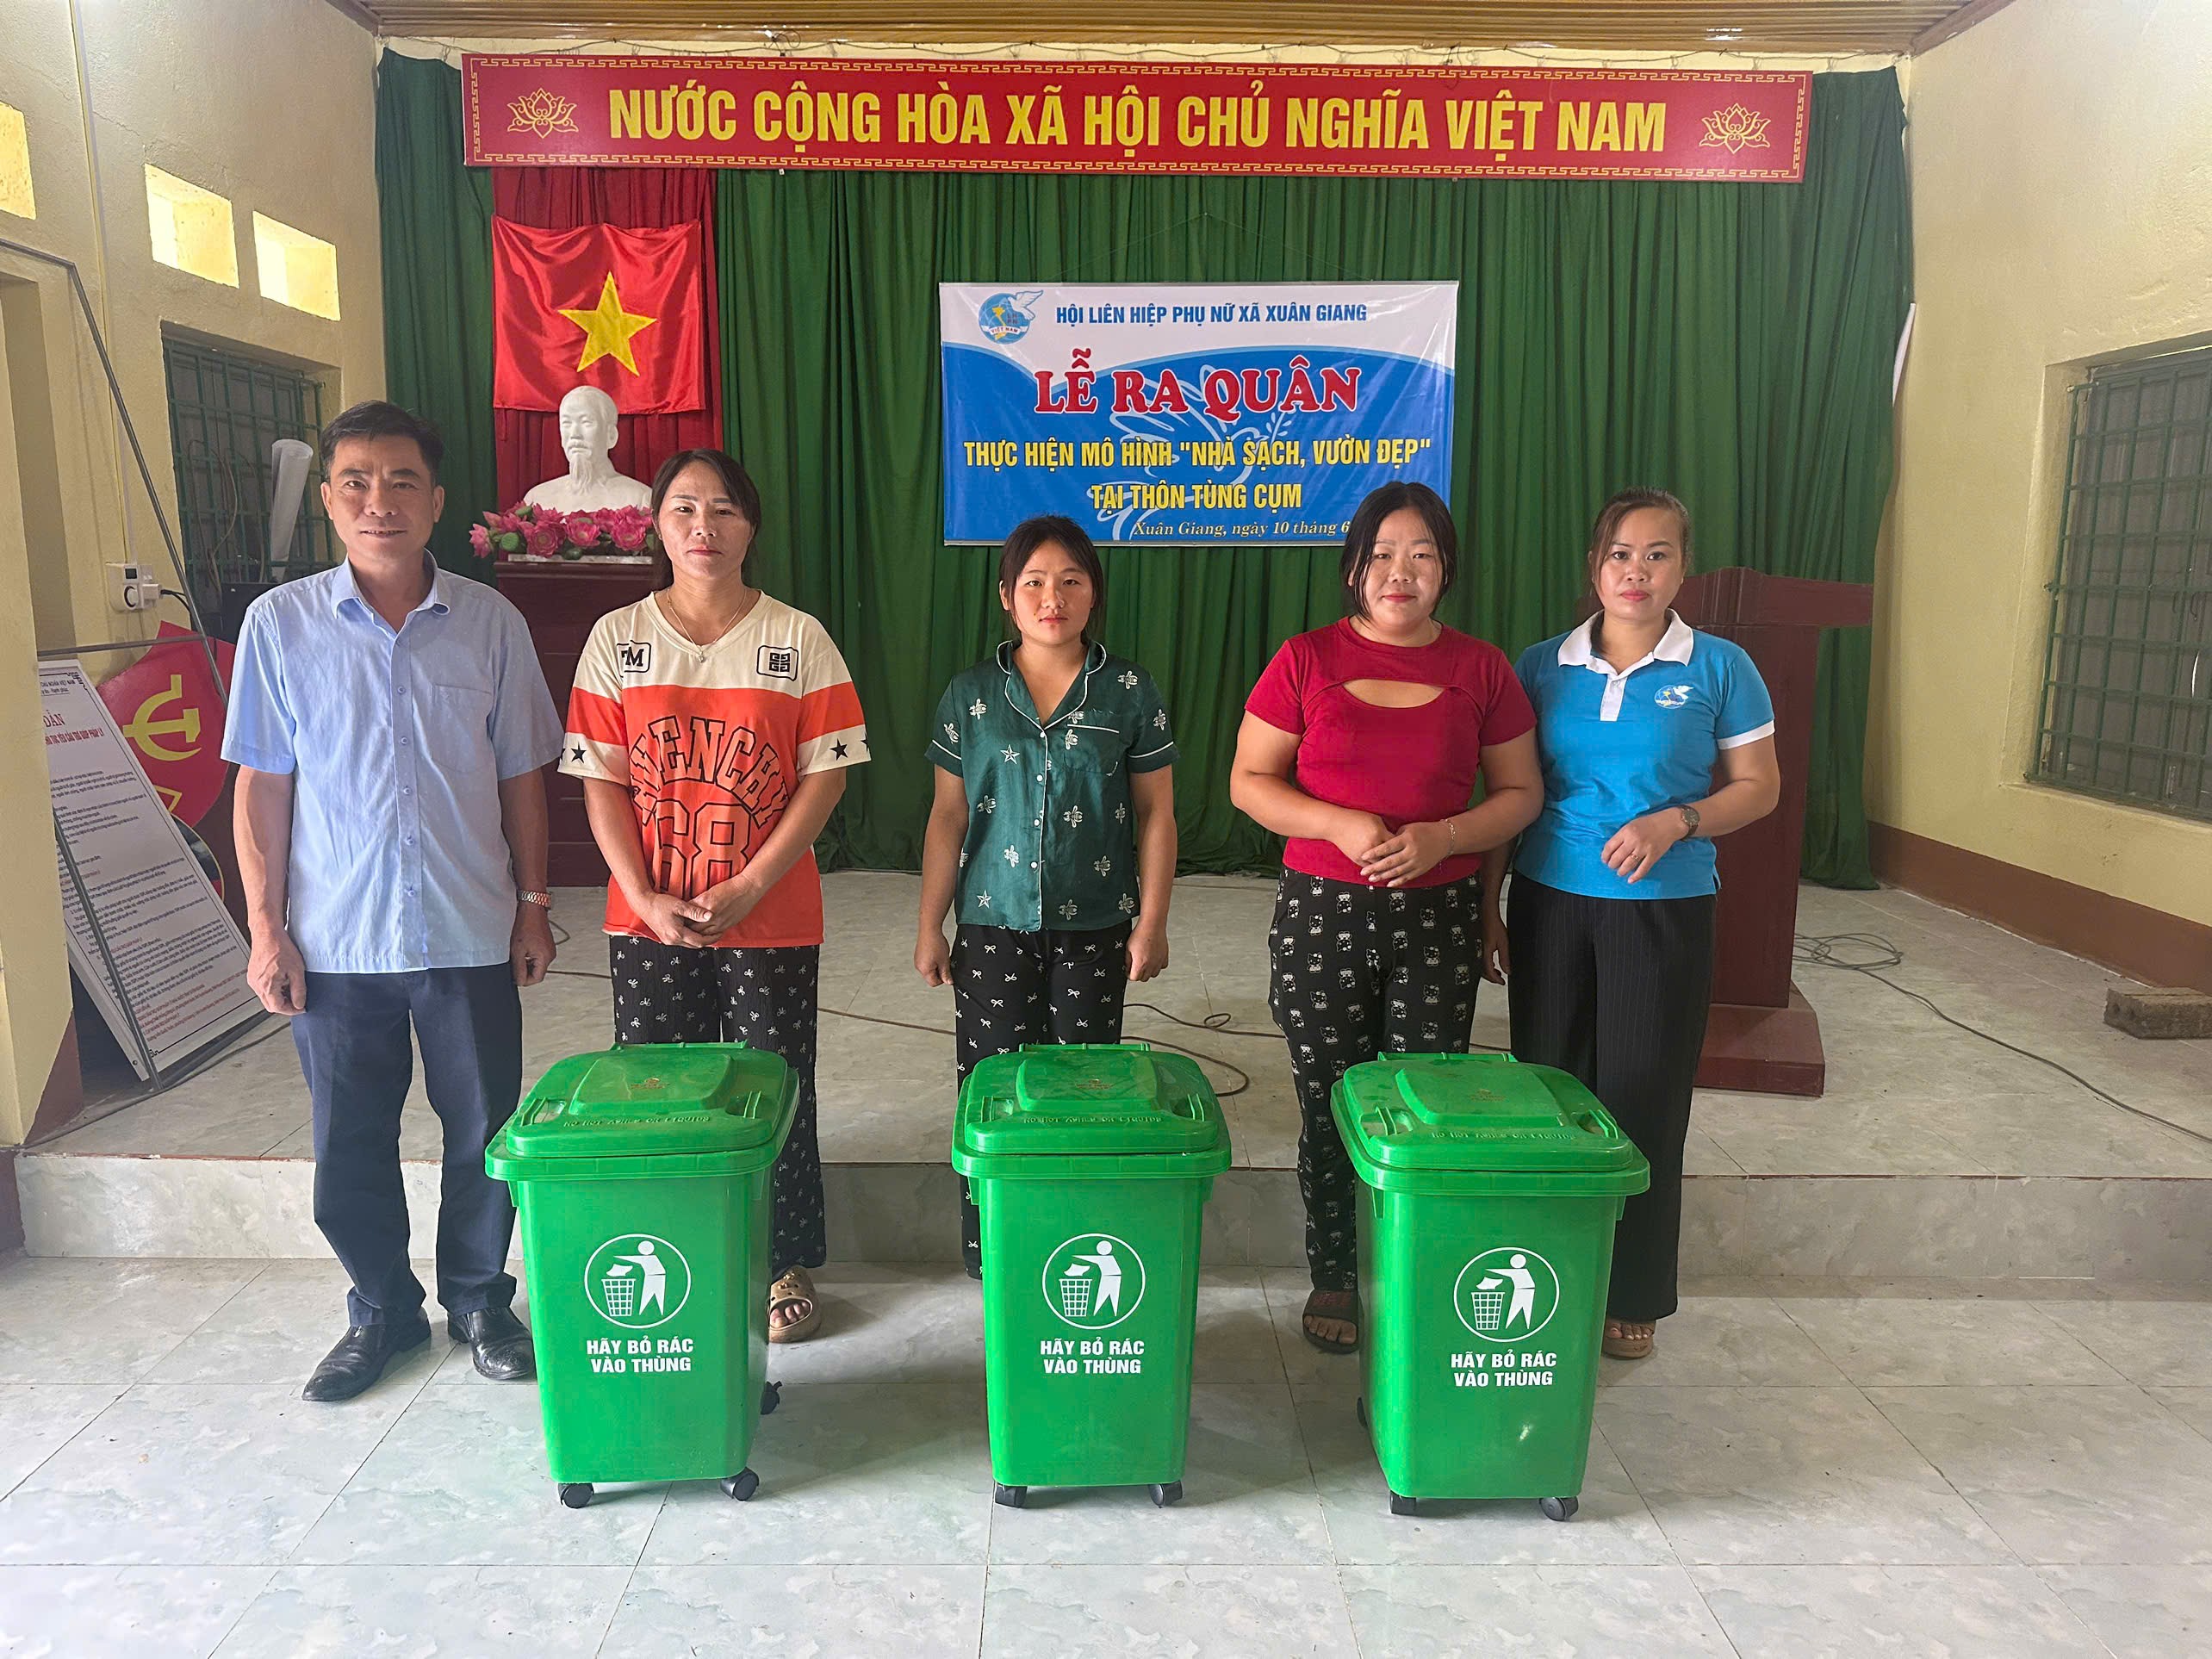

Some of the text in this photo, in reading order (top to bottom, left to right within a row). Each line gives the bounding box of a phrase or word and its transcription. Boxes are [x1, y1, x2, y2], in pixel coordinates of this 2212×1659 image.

[609, 79, 1667, 162] NƯỚC CỘNG HÒA XÃ HỘI CHỦ NGHĨA VIỆT NAM
[1056, 301, 1367, 327] HỘI LIÊN HIỆP PHỤ NỮ XÃ XUÂN GIANG
[1033, 347, 1362, 423] LỄ RA QUÂN
[963, 433, 1432, 473] THỰC HIỆN MÔ HÌNH "NHÀ SẠCH, VƯỜN ĐẸP"
[1090, 479, 1302, 515] TẠI THÔN TÙNG CỤM
[1134, 521, 1173, 535] Xuân
[1177, 521, 1227, 537] Giang,
[1231, 521, 1269, 540] ngày
[1272, 521, 1289, 535] 10
[1292, 520, 1337, 538] tháng
[587, 1335, 693, 1355] HÃY BỎ RÁC
[1040, 1336, 1145, 1356] HÃY BỎ RÁC
[591, 1355, 691, 1373] VÀO THÙNG
[1043, 1357, 1141, 1374] VÀO THÙNG
[1451, 1349, 1557, 1368] HÃY BỎ RÁC
[1454, 1369, 1553, 1387] VÀO THÙNG
